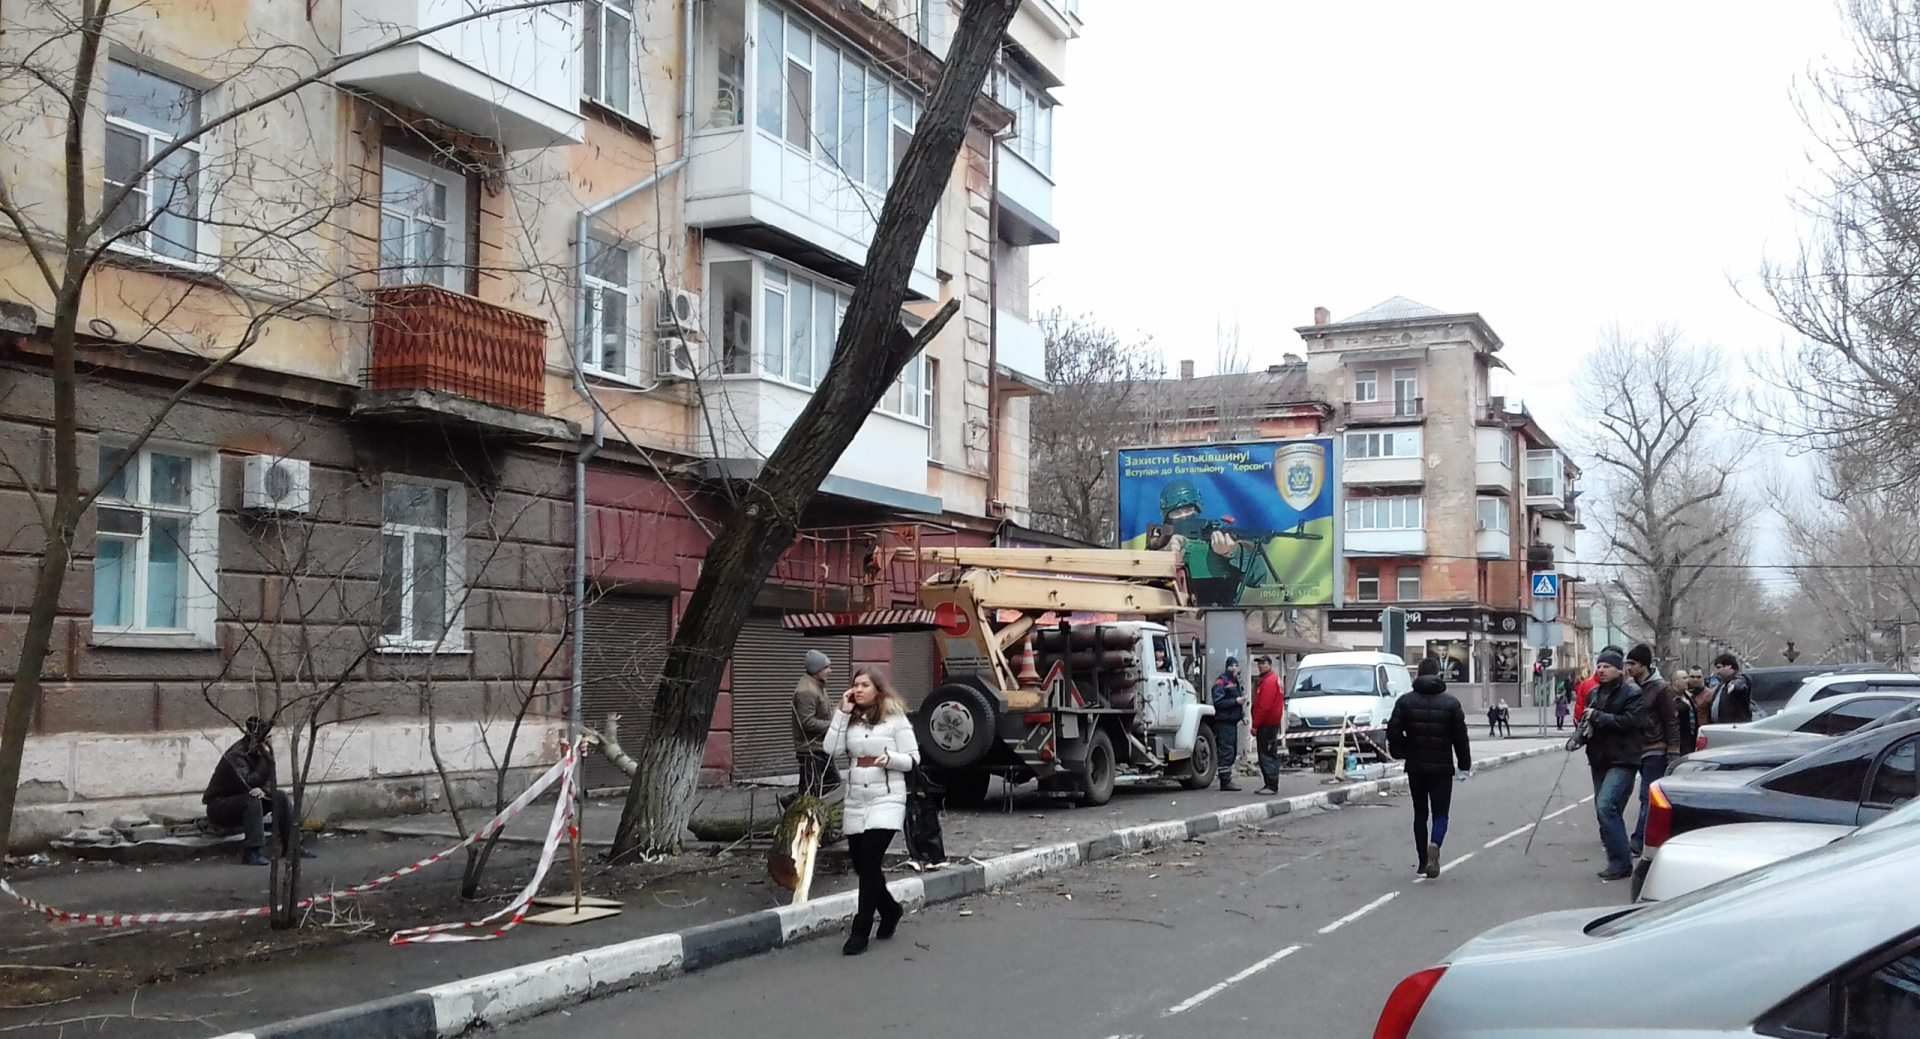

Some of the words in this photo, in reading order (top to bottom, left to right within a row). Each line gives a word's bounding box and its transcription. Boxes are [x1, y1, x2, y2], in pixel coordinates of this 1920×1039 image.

[1125, 456, 1169, 467] Захисти
[1173, 450, 1250, 464] Батьківщину!
[1161, 467, 1172, 475] до
[1174, 464, 1225, 474] батальйону
